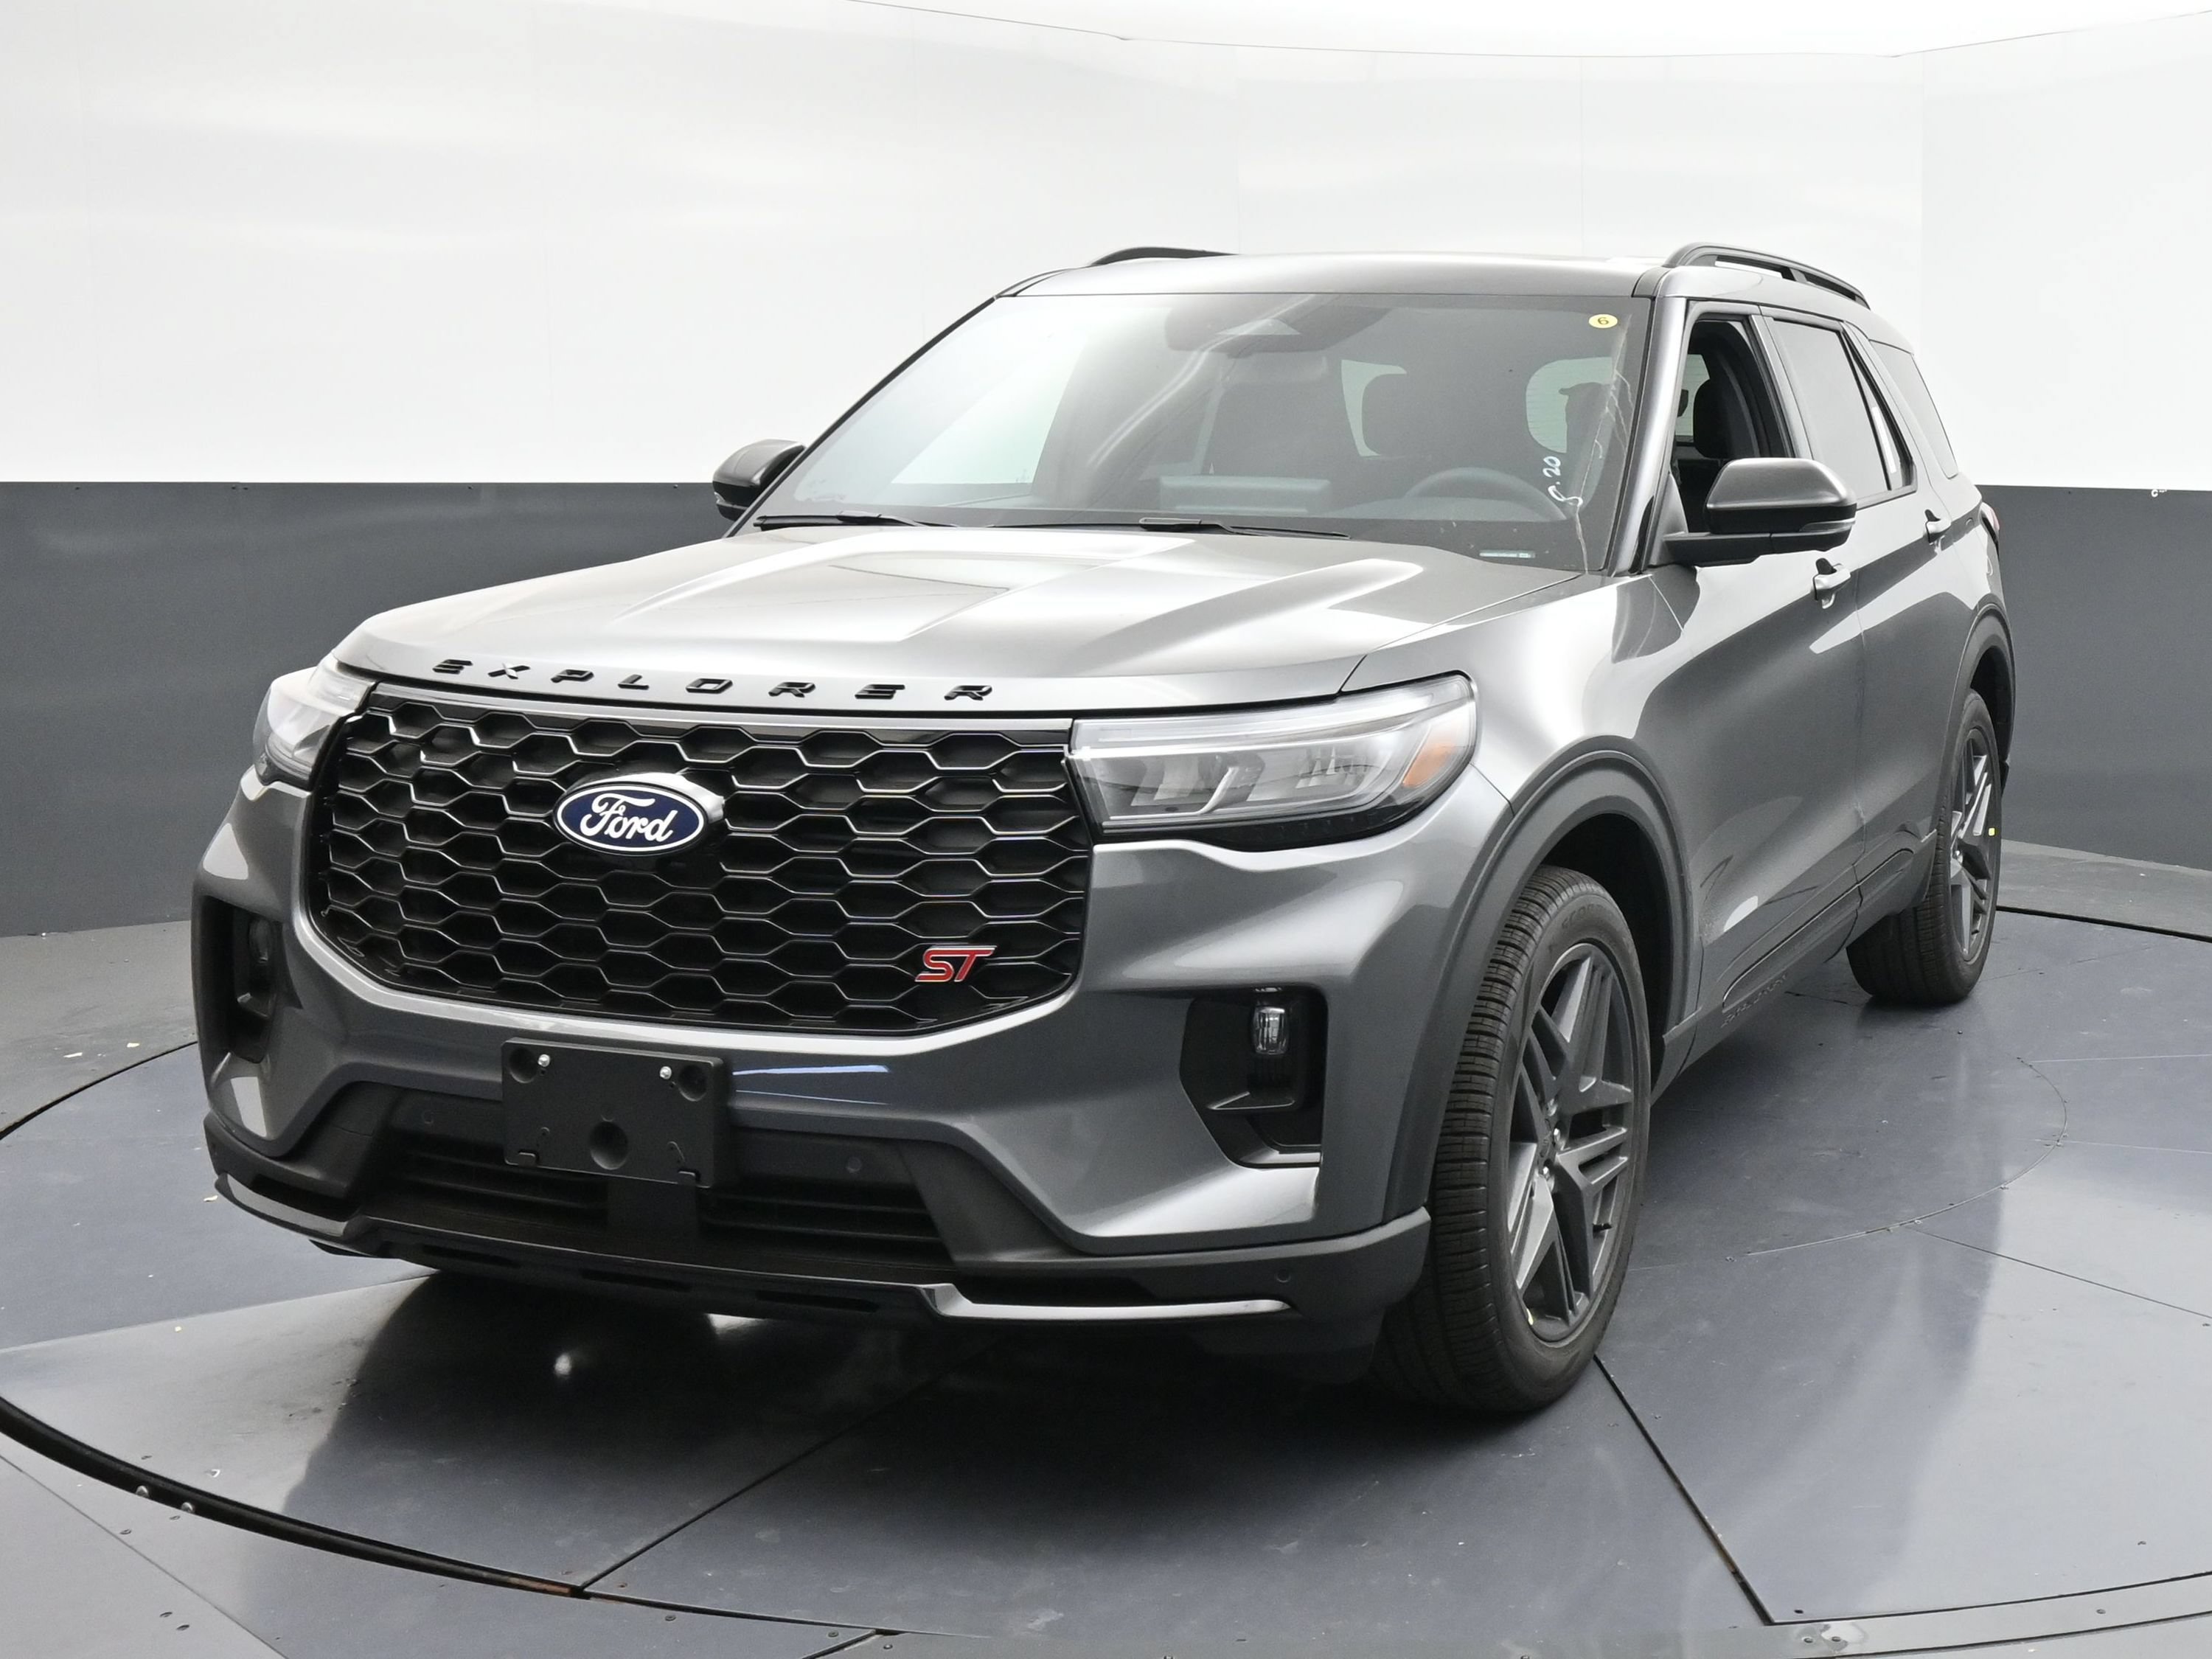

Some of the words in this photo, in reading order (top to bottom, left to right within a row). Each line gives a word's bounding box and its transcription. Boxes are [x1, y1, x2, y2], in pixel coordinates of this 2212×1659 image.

[1596, 316, 1610, 326] 6
[431, 658, 993, 702] EXPLORER
[580, 793, 678, 843] Ford
[914, 945, 996, 983] ST
